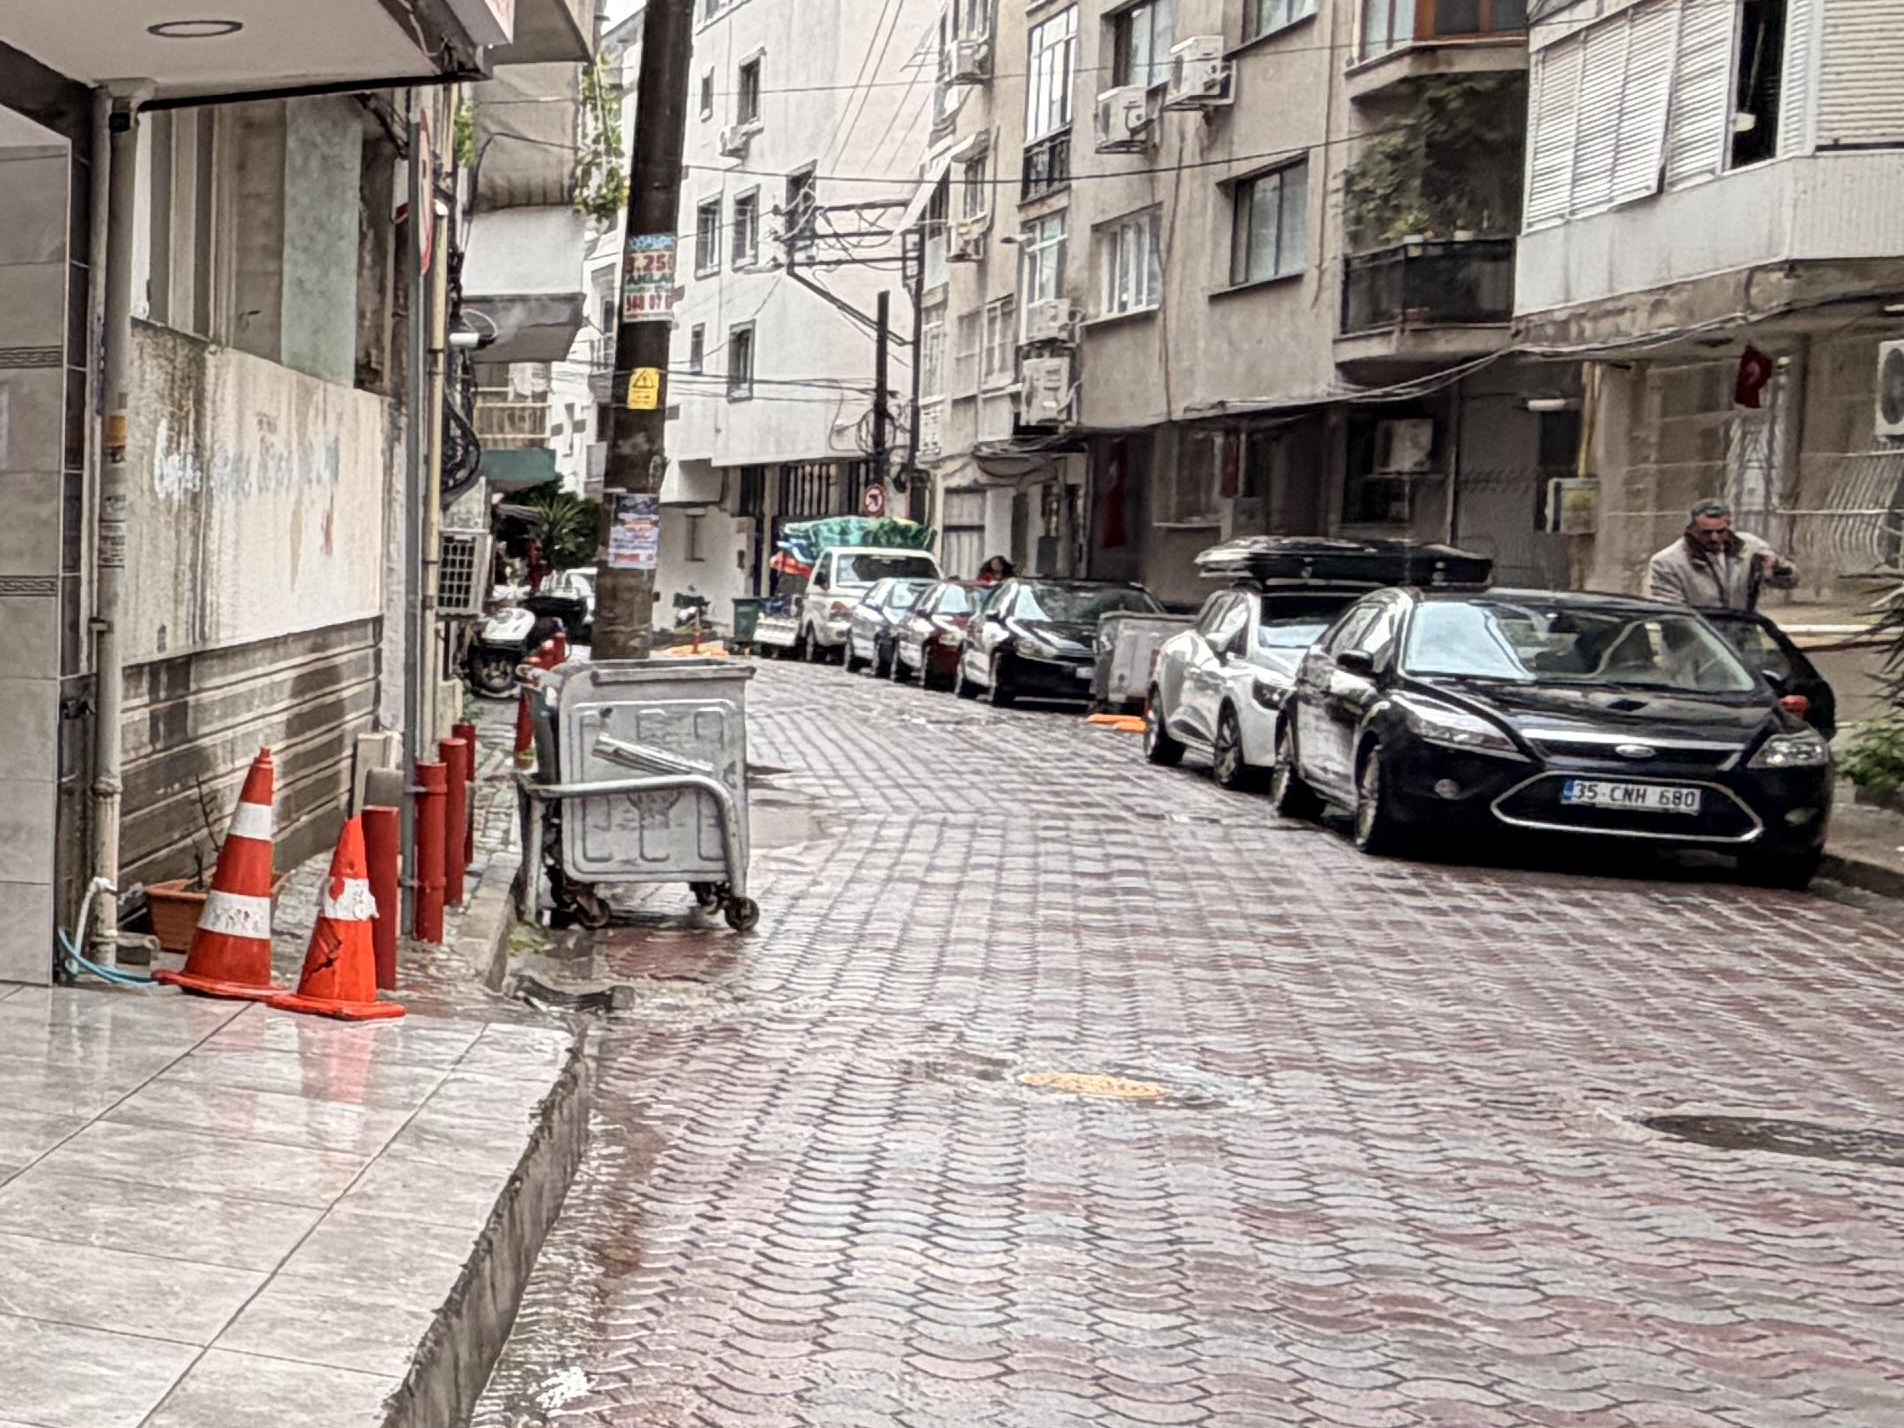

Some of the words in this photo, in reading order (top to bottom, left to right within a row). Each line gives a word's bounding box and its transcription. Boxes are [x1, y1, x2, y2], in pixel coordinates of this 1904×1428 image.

[1574, 782, 1599, 800] 35
[1609, 786, 1648, 804] CNH
[1658, 789, 1696, 808] 680
